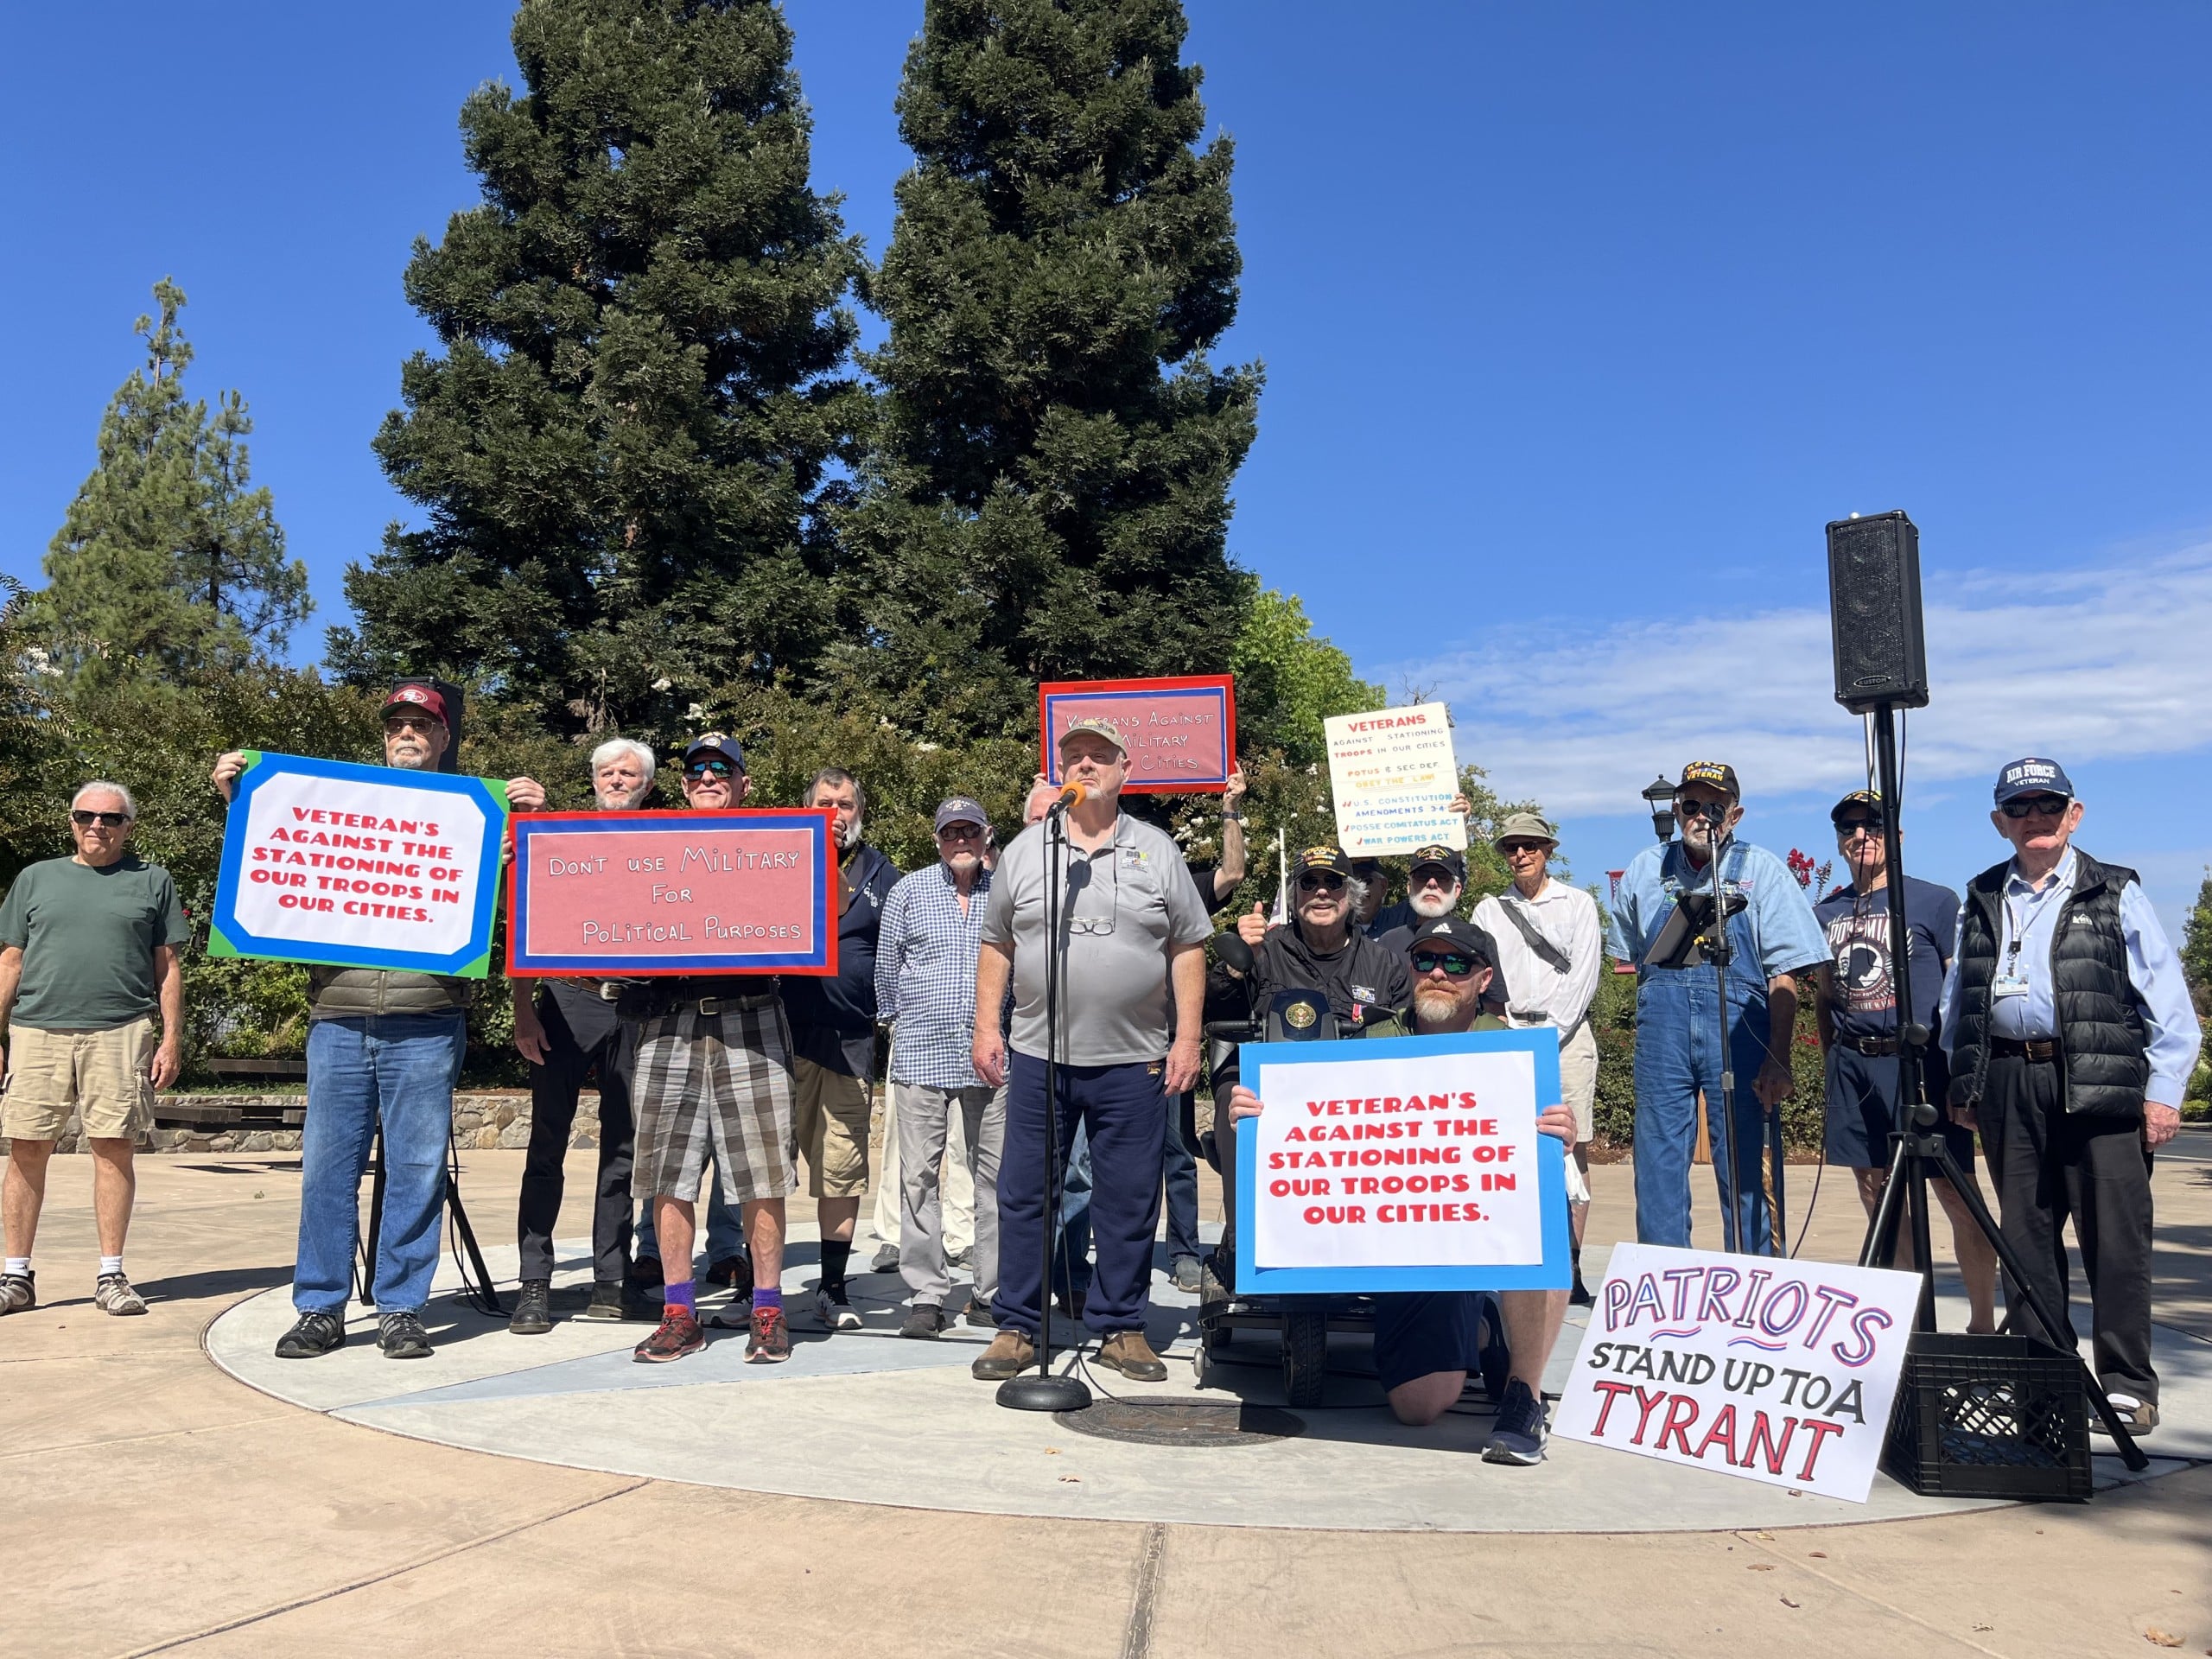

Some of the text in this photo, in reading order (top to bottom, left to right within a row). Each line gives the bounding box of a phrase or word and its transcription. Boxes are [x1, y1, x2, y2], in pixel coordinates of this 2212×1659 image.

[1348, 715, 1427, 733] VETERANS
[1333, 728, 1444, 747] AGAINST STATIONING
[1334, 748, 1373, 759] TROOPS
[1416, 741, 1446, 749] CITIES
[1347, 768, 1380, 777] POTUS
[1385, 776, 1404, 785] THE
[1687, 772, 1724, 782] VETERAN
[2006, 764, 2056, 783] AIR FORCE
[2014, 778, 2050, 786] VETERAN
[1378, 793, 1452, 805] CONSTITUTION
[292, 807, 439, 837] VETERAN'S
[1350, 823, 1382, 831] POSSE
[1383, 819, 1437, 830] COMITATUS
[270, 827, 454, 861] AGAINST THE
[1363, 832, 1450, 845] WAR POWERS ACT
[252, 847, 464, 882] STATIONING OF
[548, 854, 608, 877] DON'T
[250, 869, 460, 904] OUR TROOPS IN
[652, 884, 694, 905] FOR
[278, 894, 434, 923] OUR CITIES.
[704, 916, 802, 940] PURPOSES
[1864, 918, 1891, 952] MIA
[1306, 1092, 1477, 1116] VETERAN'S
[1284, 1119, 1499, 1142] AGAINST THE
[1268, 1145, 1516, 1170] STATIONING OF
[1268, 1173, 1516, 1198] OUR TROOPS IN
[1303, 1202, 1491, 1225] OUR CITIES.
[1605, 1266, 1893, 1368] PATRIOTS
[1587, 1342, 1866, 1426] STAND UP TO A
[1591, 1380, 1845, 1482] TYRANT
